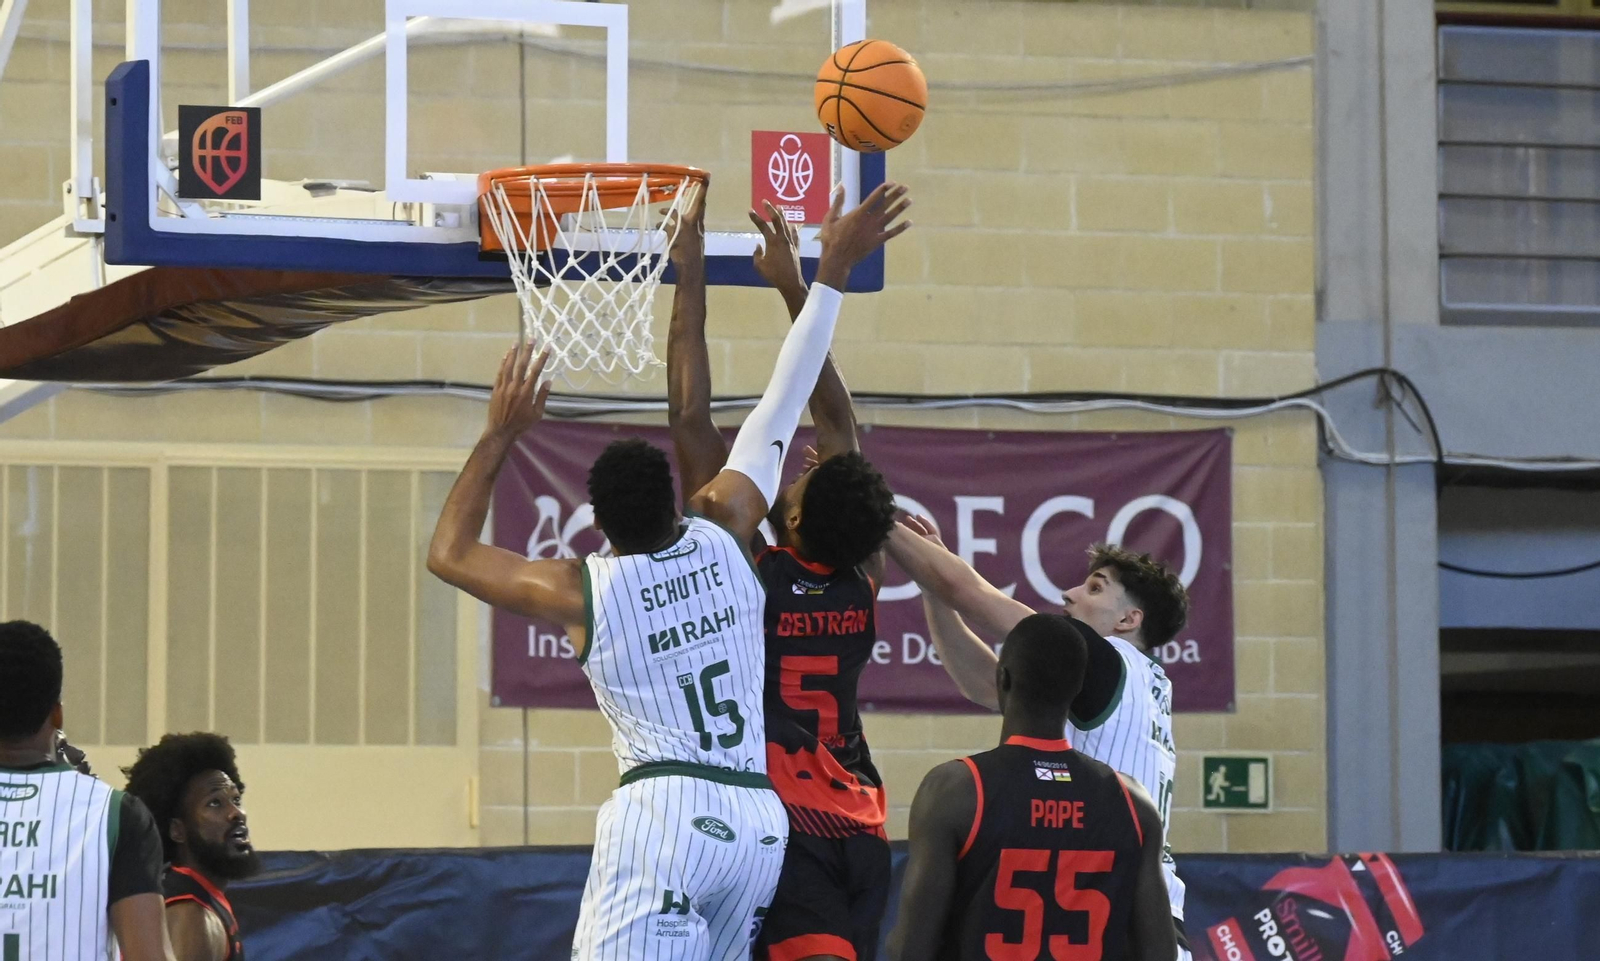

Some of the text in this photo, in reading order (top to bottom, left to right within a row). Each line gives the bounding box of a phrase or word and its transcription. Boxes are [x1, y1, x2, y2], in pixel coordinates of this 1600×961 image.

[225, 115, 243, 125] FEB
[783, 210, 805, 221] EB
[640, 561, 723, 613] SCHUTTE
[681, 605, 736, 644] RAHI
[652, 636, 720, 664] SOLUCIONES INTEGRALES
[677, 659, 745, 752] 15
[780, 655, 839, 742] 5
[701, 818, 729, 839] Ford
[1031, 799, 1084, 829] PAPE
[0, 874, 57, 899] AHI
[984, 848, 1116, 961] 55
[656, 919, 689, 928] Hospital
